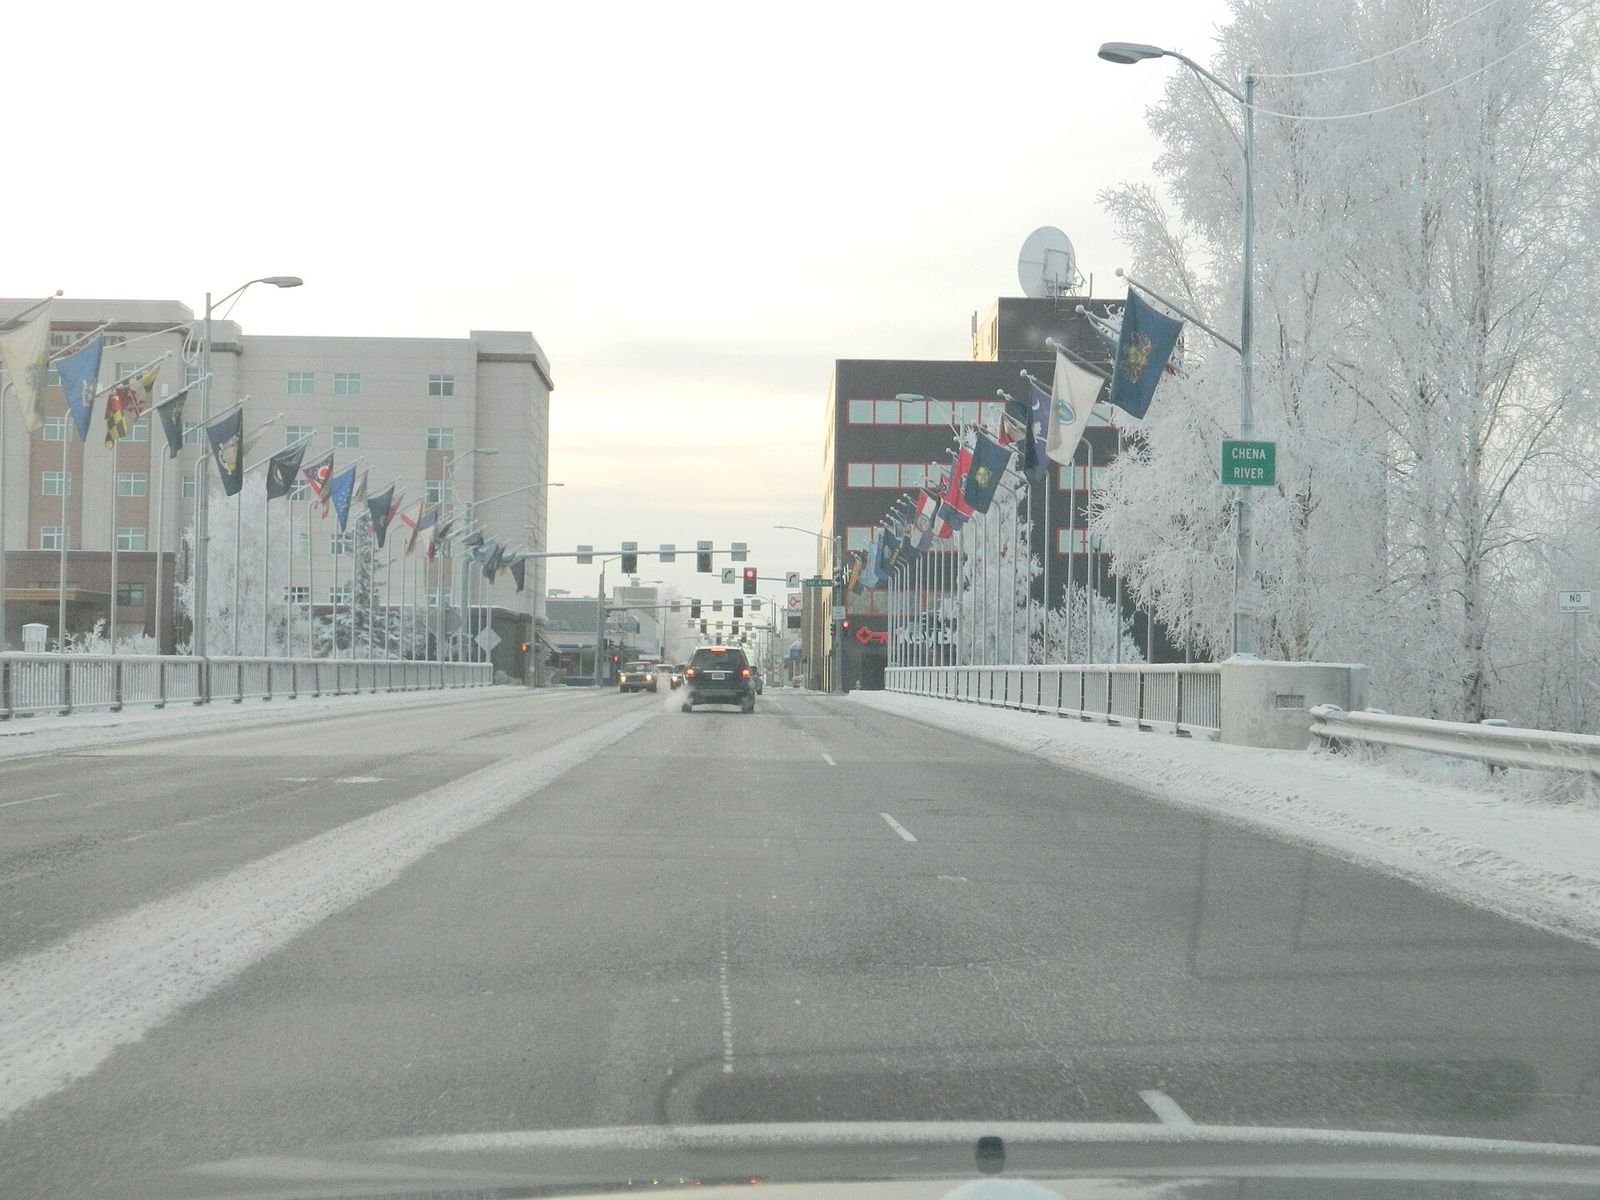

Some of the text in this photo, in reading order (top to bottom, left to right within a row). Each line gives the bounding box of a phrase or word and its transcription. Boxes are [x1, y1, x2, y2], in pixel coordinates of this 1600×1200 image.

[1231, 447, 1266, 460] CHENA
[1233, 467, 1264, 479] RIVER
[1569, 594, 1581, 603] NO
